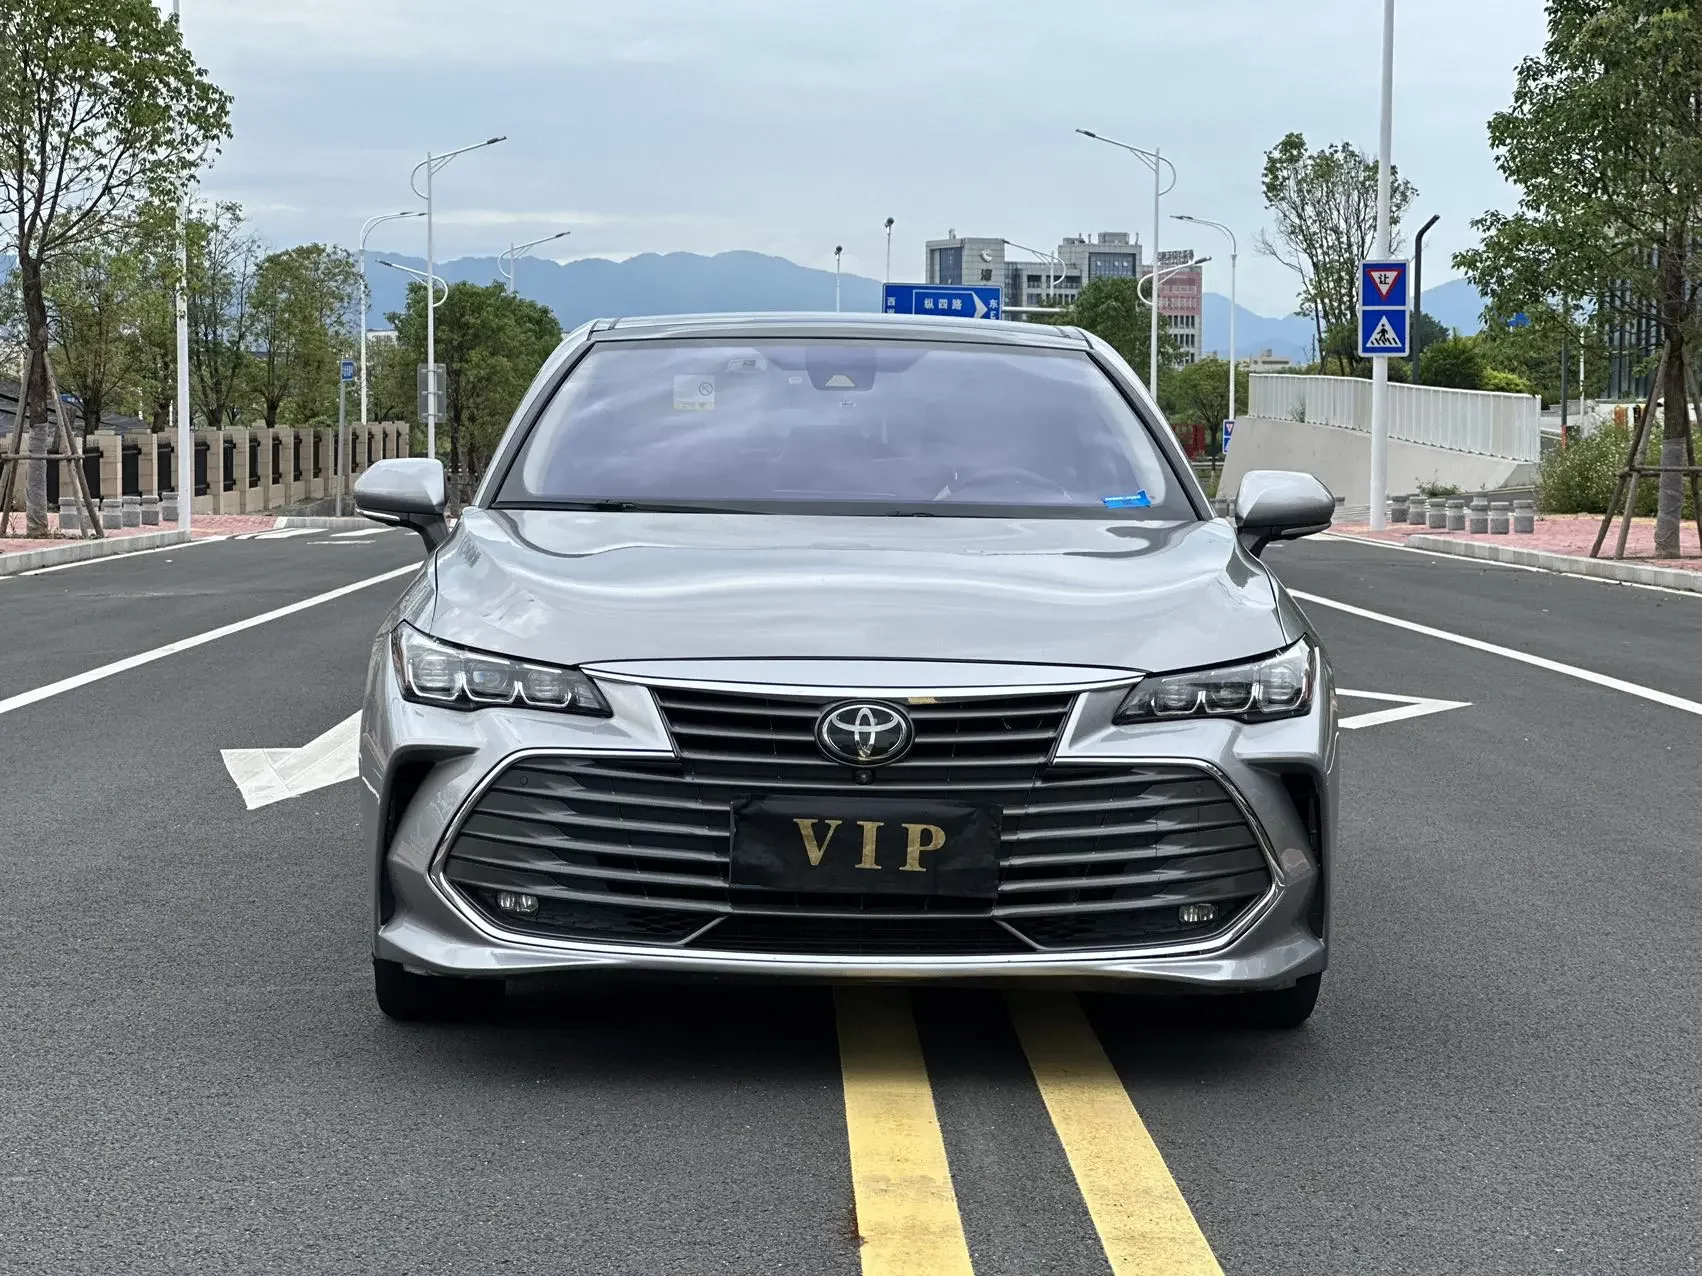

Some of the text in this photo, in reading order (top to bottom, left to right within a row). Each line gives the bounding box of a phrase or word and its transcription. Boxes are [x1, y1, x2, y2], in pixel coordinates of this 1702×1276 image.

[1378, 273, 1390, 285] 让
[887, 297, 896, 306] 西
[924, 298, 962, 310] 纵四路
[989, 299, 998, 309] 东
[793, 818, 946, 872] VIP
